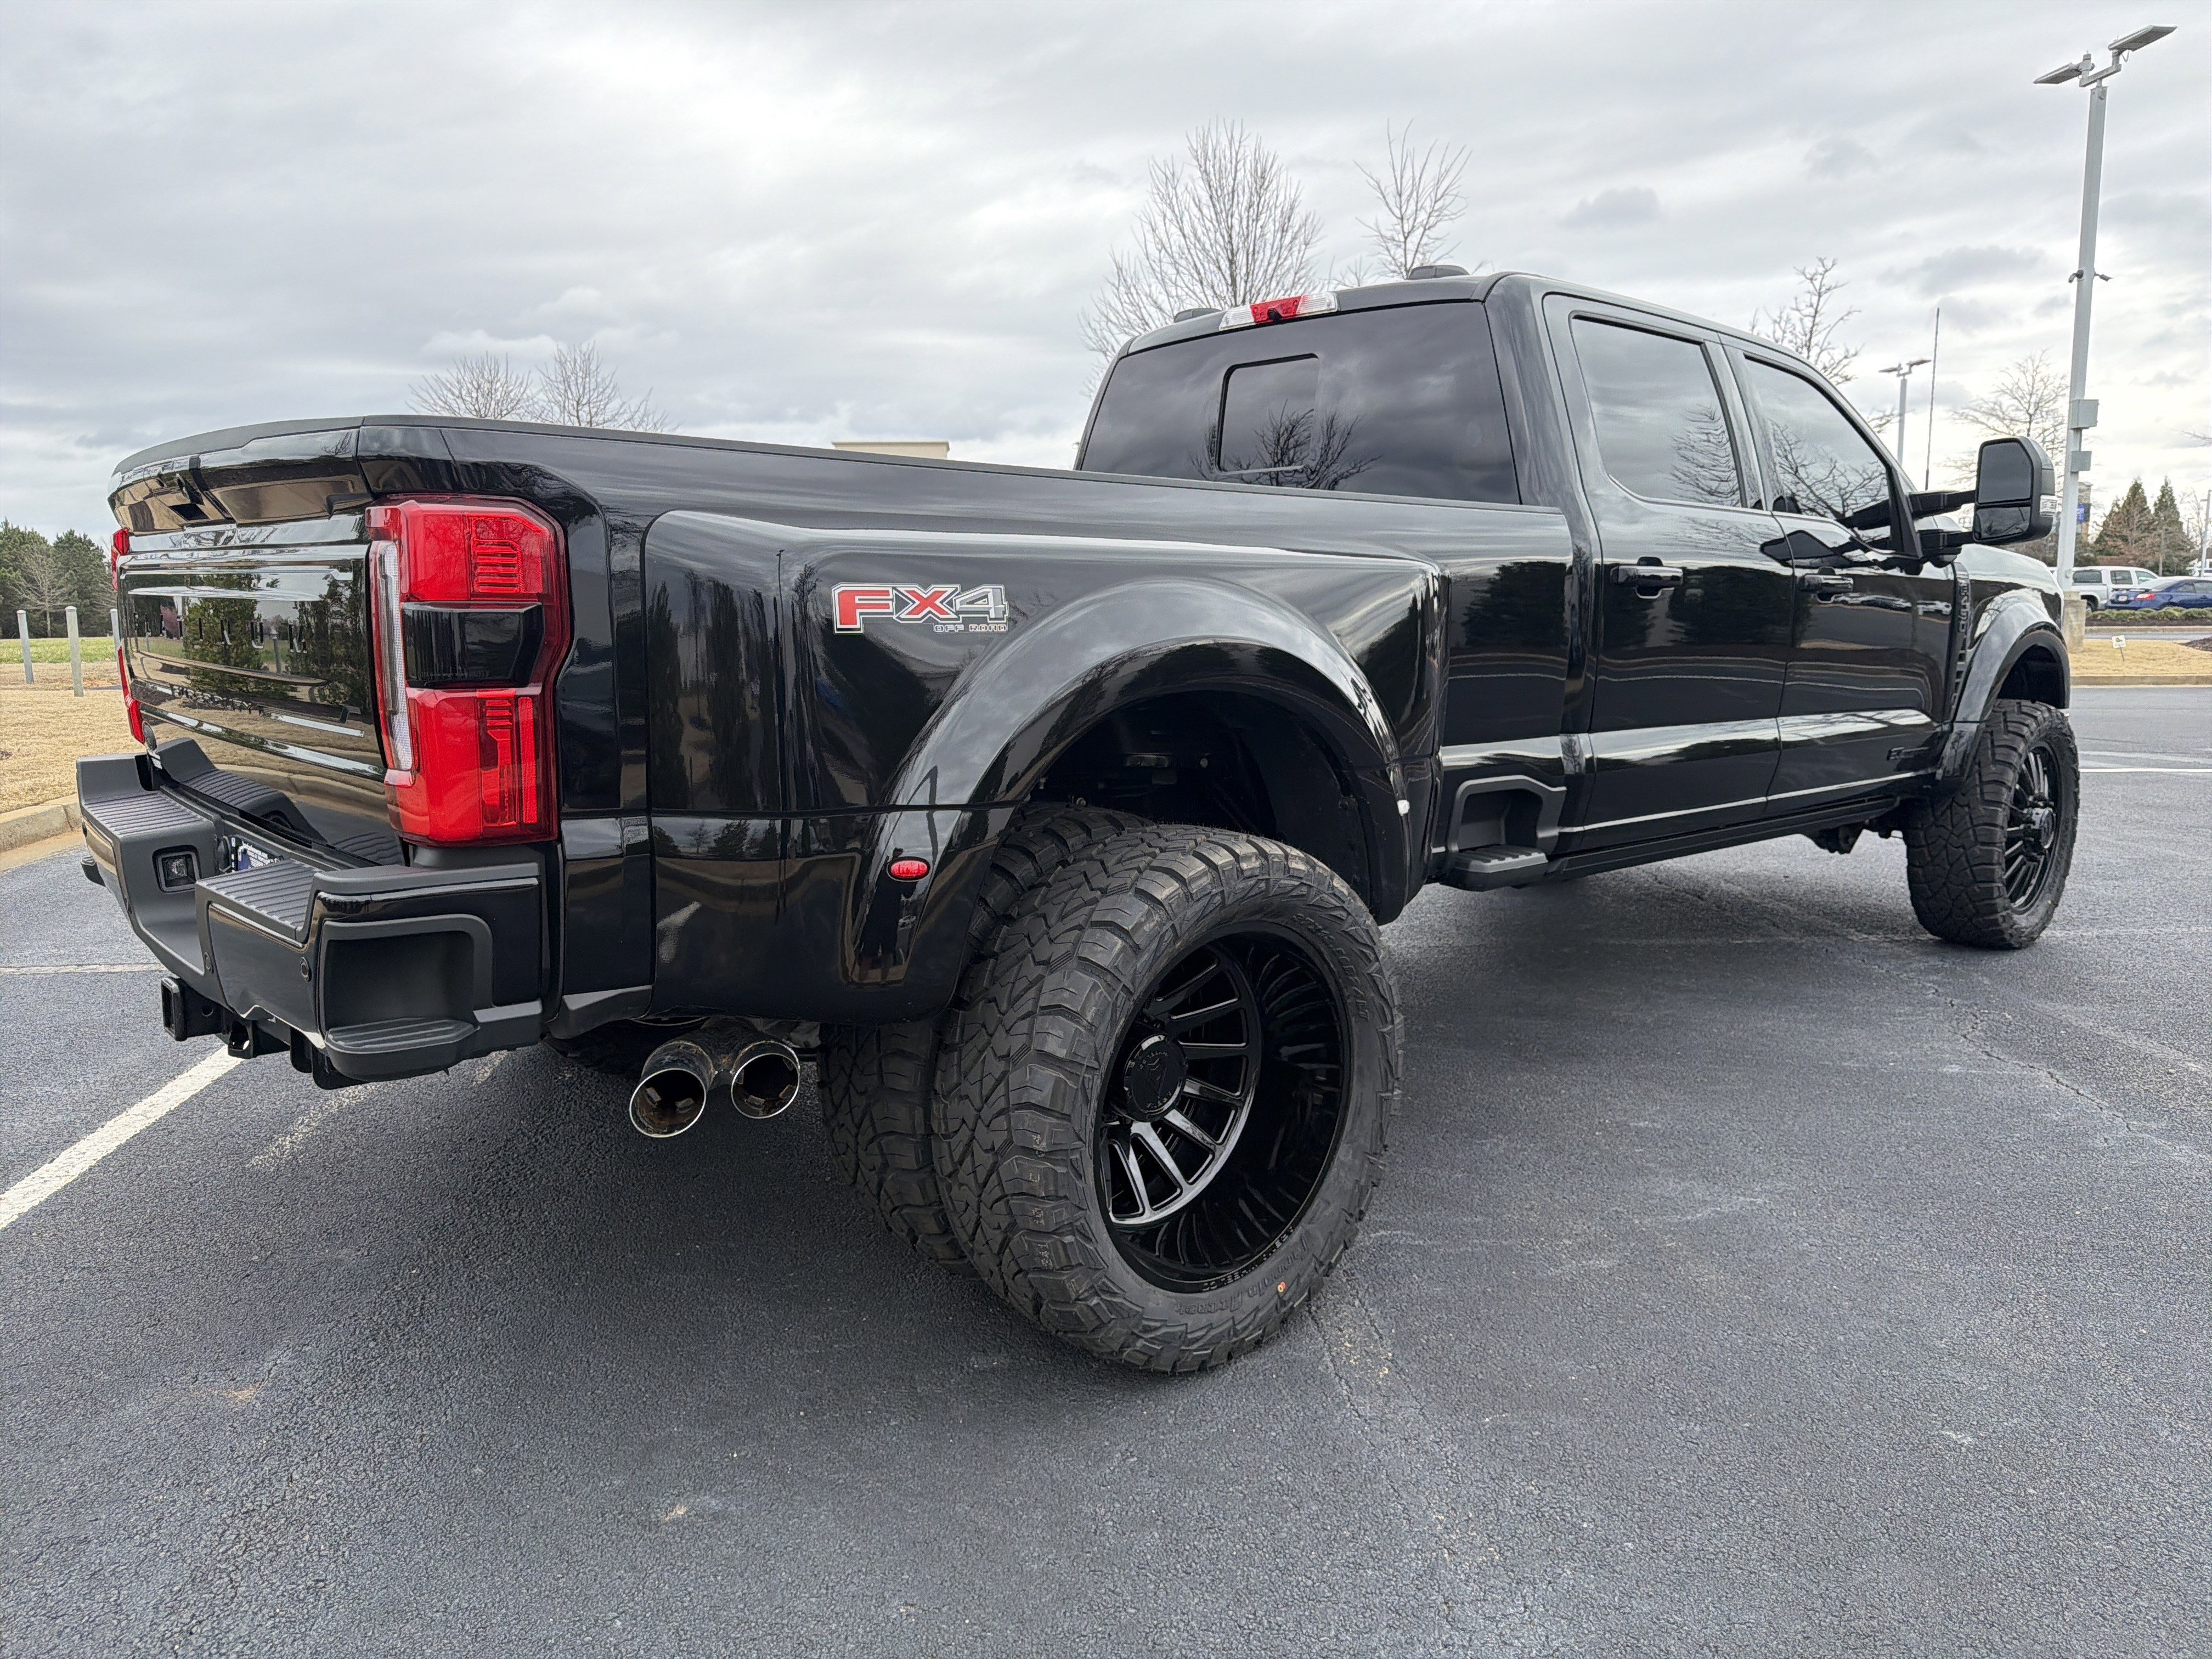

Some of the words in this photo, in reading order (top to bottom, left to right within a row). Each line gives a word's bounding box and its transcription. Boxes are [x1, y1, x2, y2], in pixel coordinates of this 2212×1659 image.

[832, 583, 1008, 634] FX4
[934, 624, 964, 632] OFF
[969, 624, 1007, 633] ROAD
